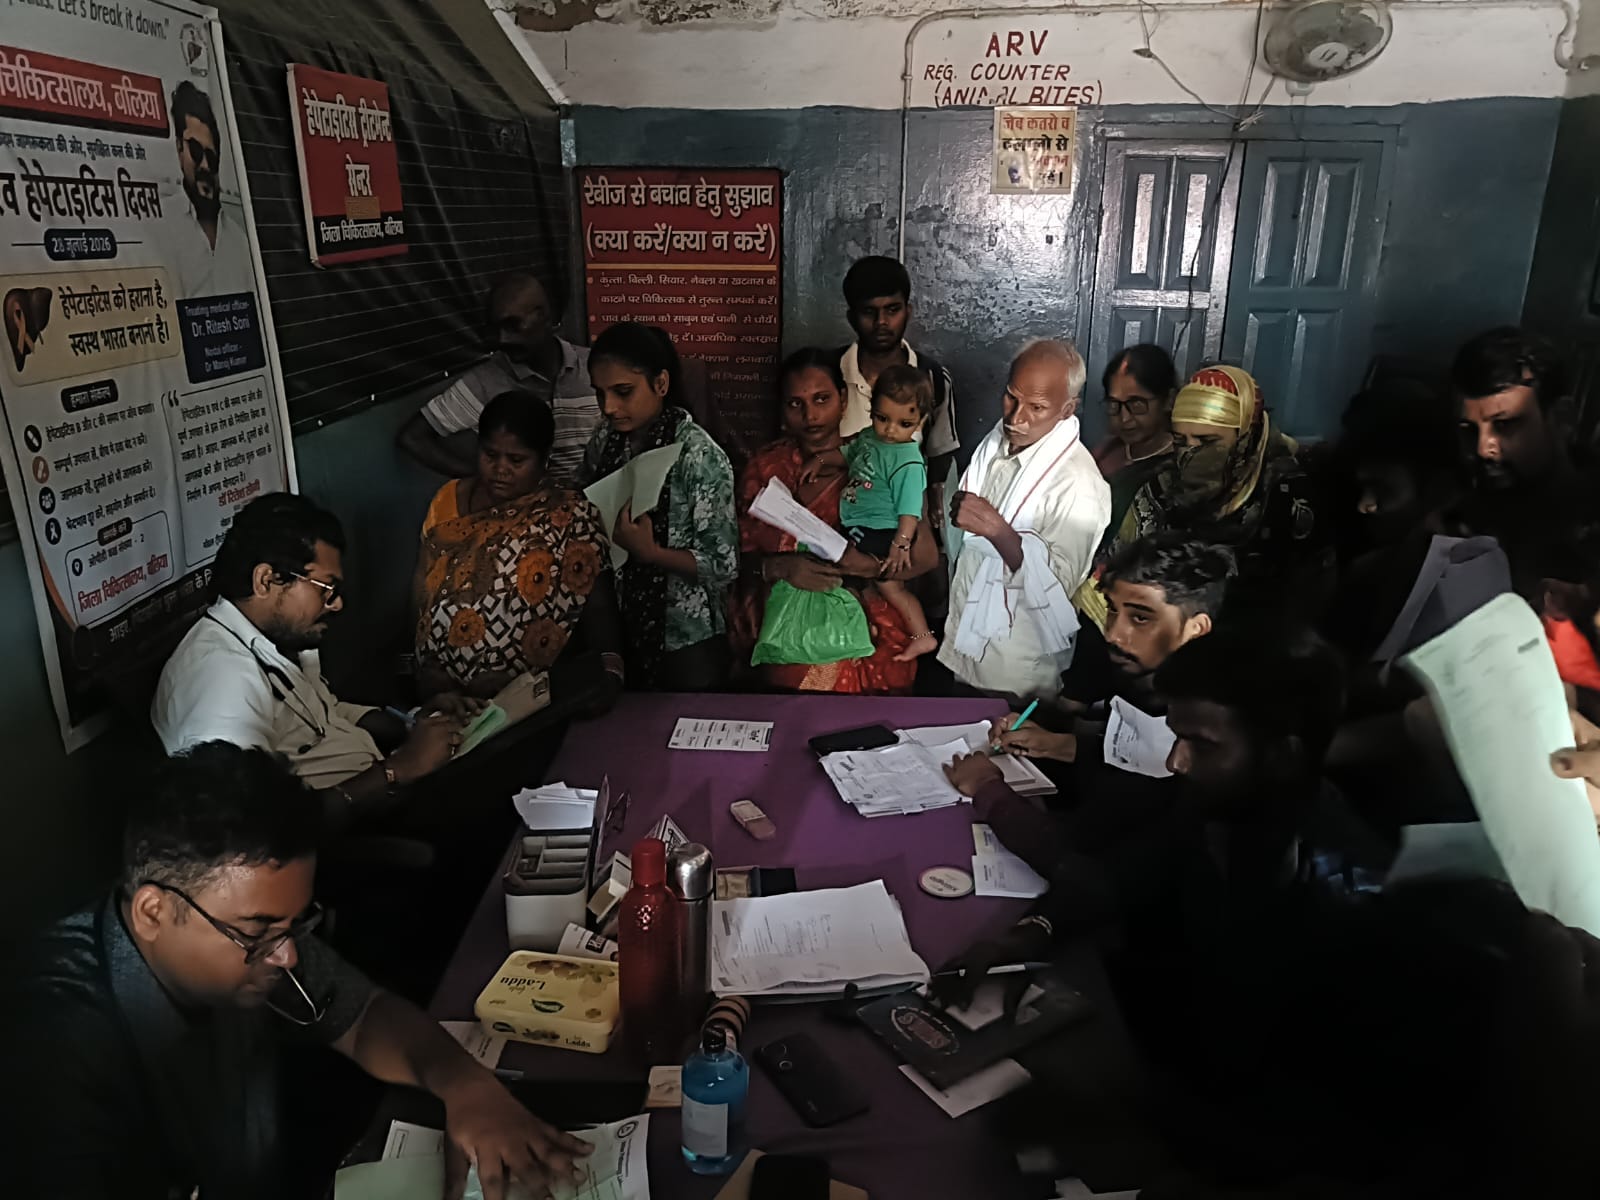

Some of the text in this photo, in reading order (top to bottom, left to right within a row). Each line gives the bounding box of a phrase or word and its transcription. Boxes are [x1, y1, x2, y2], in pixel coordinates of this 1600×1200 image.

[90, 1, 123, 28] break
[126, 7, 134, 31] it
[986, 30, 1048, 57] ARV
[924, 63, 1071, 82] REG. COUNTER
[1029, 80, 1102, 106] BITES)
[302, 87, 359, 144] हेपेटाइटिस
[1056, 134, 1069, 151] से
[345, 153, 373, 196] सेन्टर
[18, 157, 119, 224] हेपेटाइटिस
[118, 167, 163, 220] दिवस
[630, 177, 646, 205] से
[649, 183, 691, 205] बचाव
[695, 177, 722, 216] हेतु
[724, 184, 773, 217] सुझाव
[64, 232, 88, 258] जुलाई
[320, 221, 341, 243] जिला
[587, 222, 628, 258] (क्या
[712, 231, 728, 250] न
[733, 223, 775, 260] करें)
[58, 279, 167, 320] हेपेटाइटिस को हराना है,
[642, 293, 685, 304] चिकित्सक
[69, 314, 170, 356] स्वस्थ भारत बनाना है।
[191, 313, 251, 337] Dr. Ritesh Soni
[78, 589, 103, 613] जिला
[500, 975, 546, 990] Laddu
